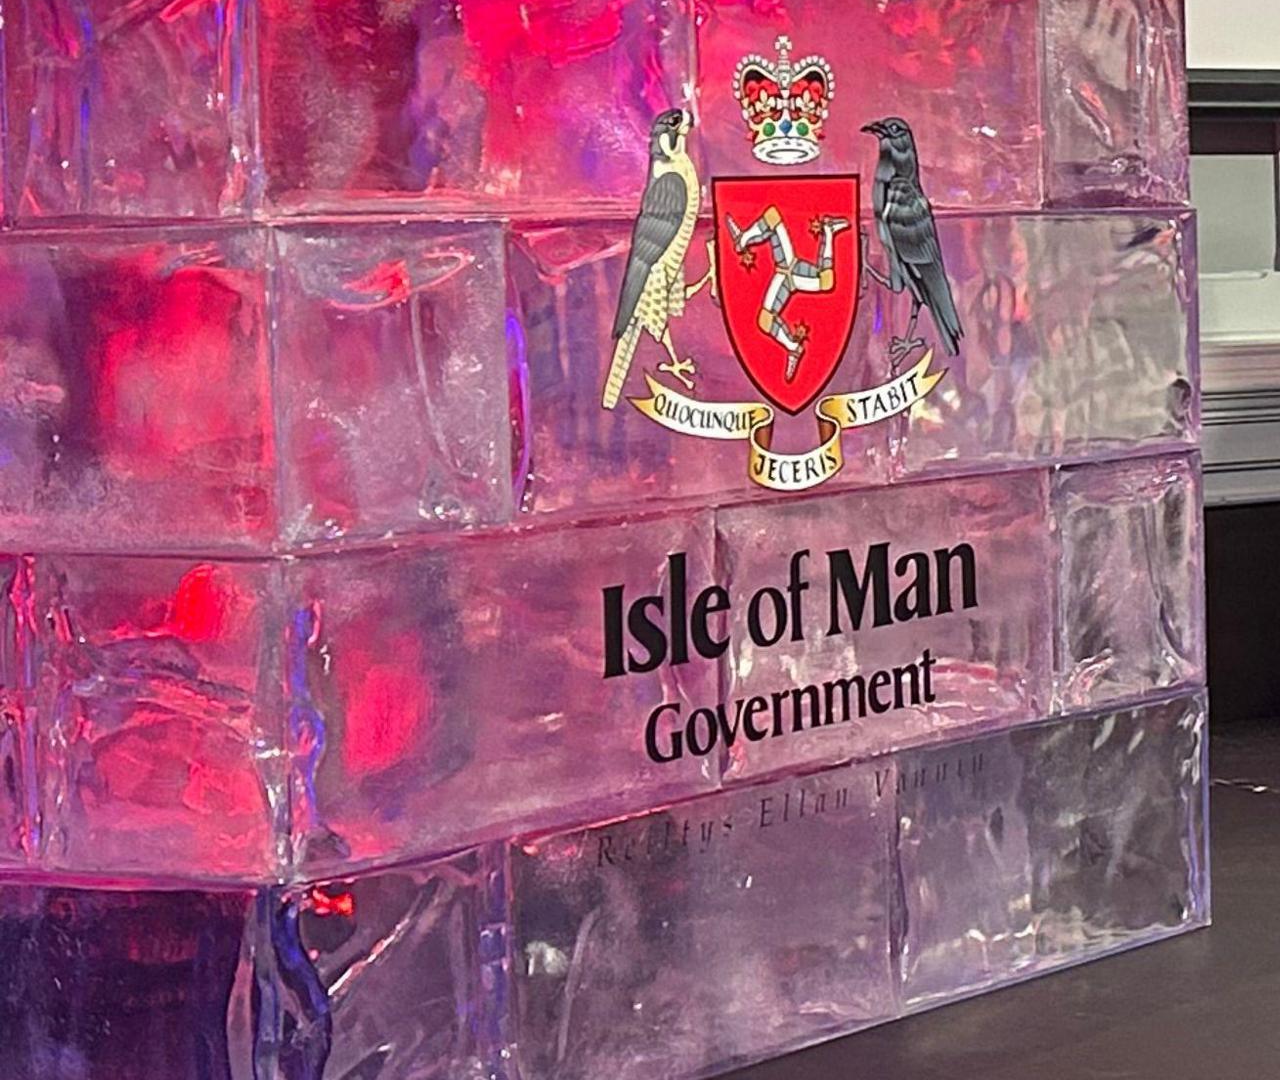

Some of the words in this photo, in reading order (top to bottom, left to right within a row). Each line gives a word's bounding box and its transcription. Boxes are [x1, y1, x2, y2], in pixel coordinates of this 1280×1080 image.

[752, 447, 839, 485] JECERIS
[846, 370, 921, 424] STABIT
[601, 551, 732, 679] Isle
[746, 548, 811, 649] of
[825, 541, 979, 637] Man
[644, 648, 937, 764] Government
